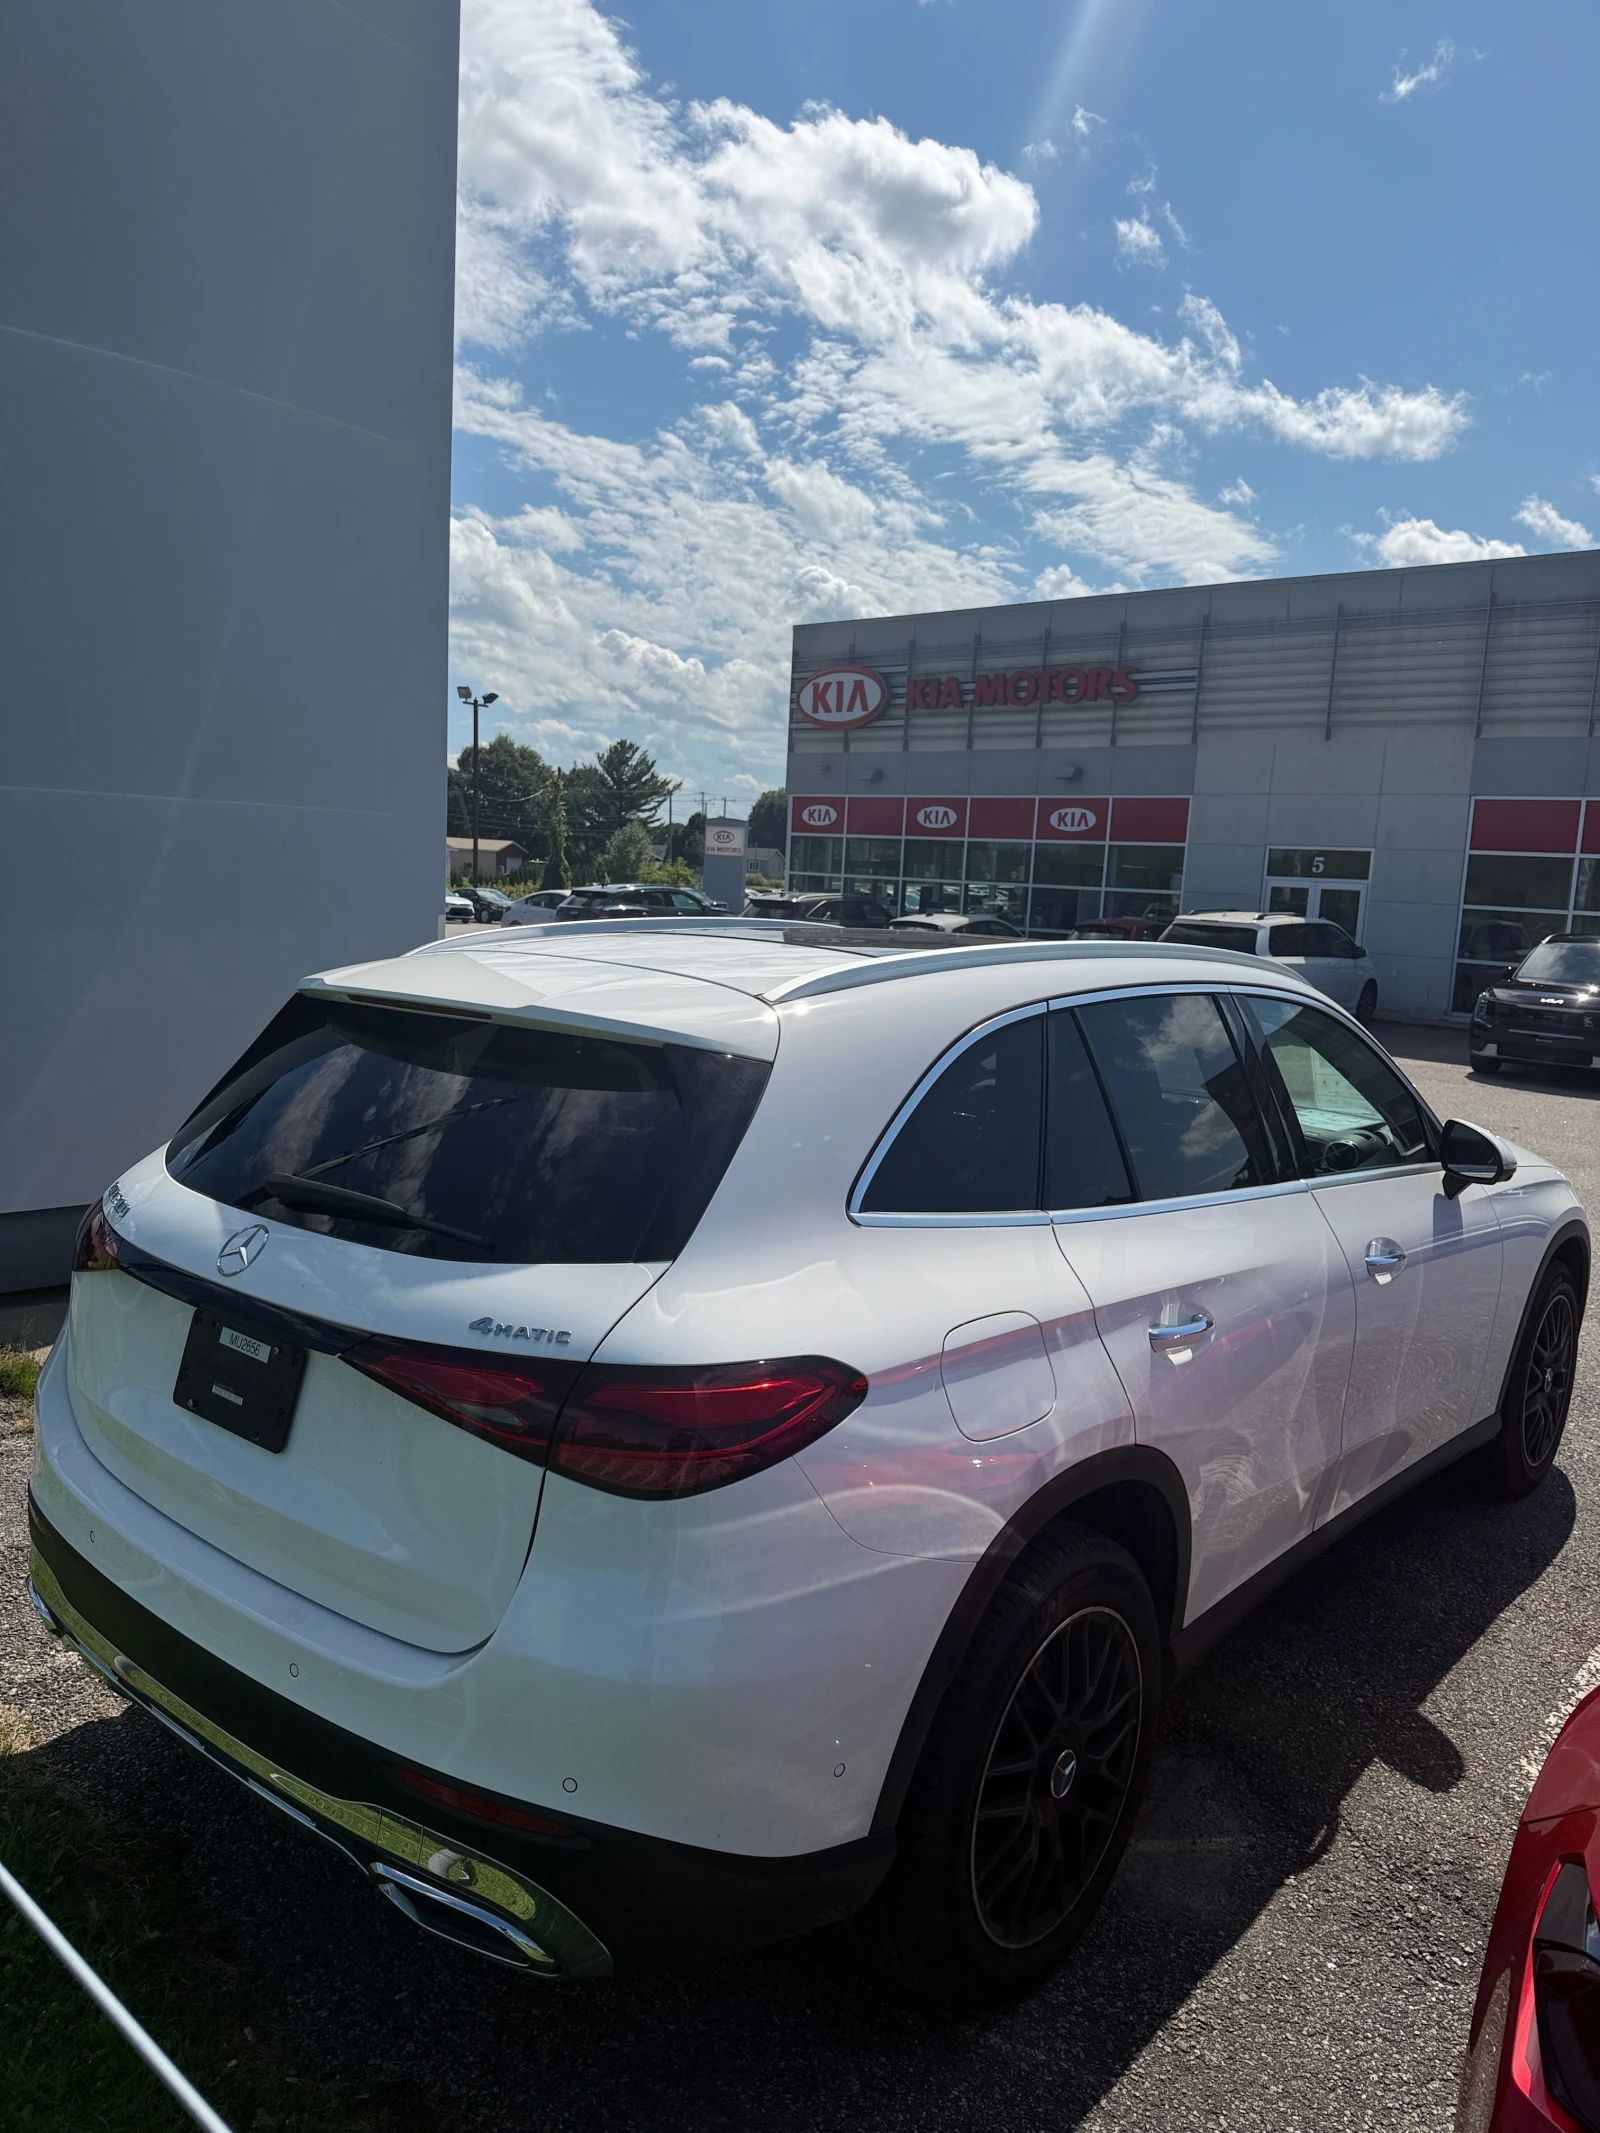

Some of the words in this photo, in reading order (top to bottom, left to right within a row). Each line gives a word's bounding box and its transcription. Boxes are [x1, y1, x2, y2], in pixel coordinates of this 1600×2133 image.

[811, 679, 869, 714] KIA
[906, 676, 963, 710] KIA
[971, 665, 1140, 707] MOTORS
[807, 808, 832, 823] KIA
[923, 810, 951, 825] KIA
[1057, 812, 1089, 828] KIA
[717, 833, 731, 841] KIA
[1312, 856, 1325, 874] 5
[468, 1316, 573, 1344] 4MATIC
[229, 1332, 261, 1357] MU2656
